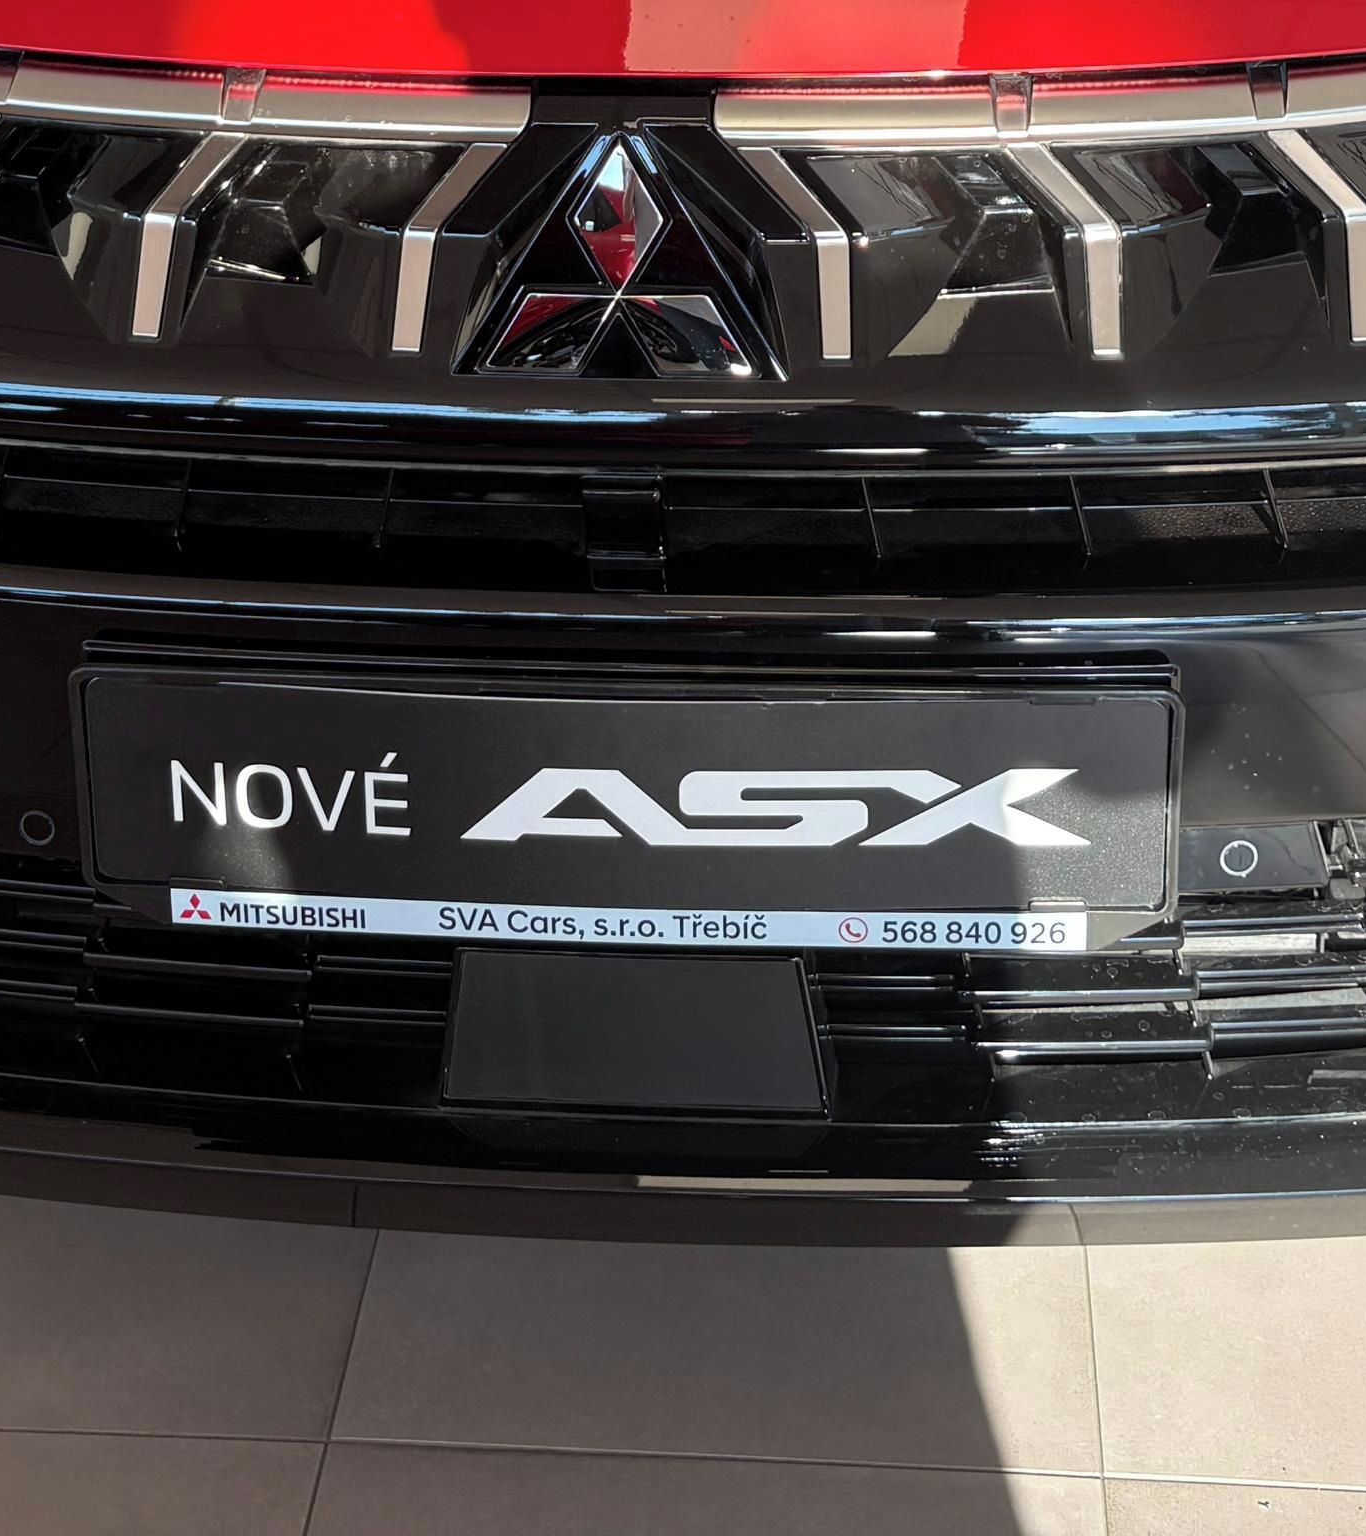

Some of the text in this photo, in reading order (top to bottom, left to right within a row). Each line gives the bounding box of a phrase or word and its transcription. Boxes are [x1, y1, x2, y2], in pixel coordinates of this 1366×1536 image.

[170, 752, 1092, 847] NOVÉ ASX
[219, 901, 367, 930] MITSUBISHI
[437, 906, 768, 941] SVA Cars, s.r.o. Třebíč
[881, 920, 1067, 946] 568 840 926
